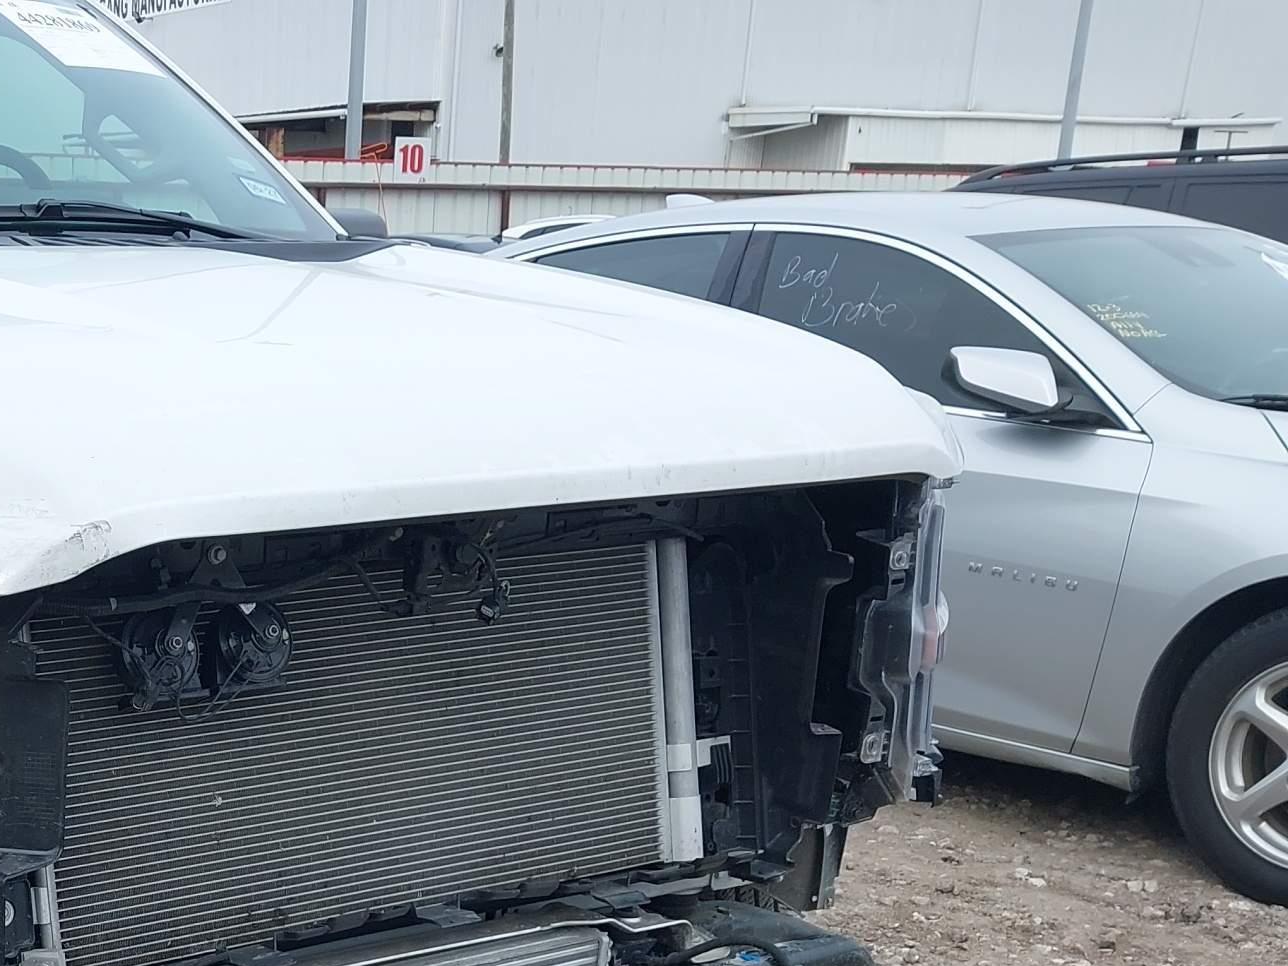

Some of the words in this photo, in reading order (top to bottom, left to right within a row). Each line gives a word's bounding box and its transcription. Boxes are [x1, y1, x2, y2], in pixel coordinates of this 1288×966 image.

[399, 144, 424, 174] 10
[779, 252, 839, 288] Bad
[968, 561, 1079, 592] MALIBU
